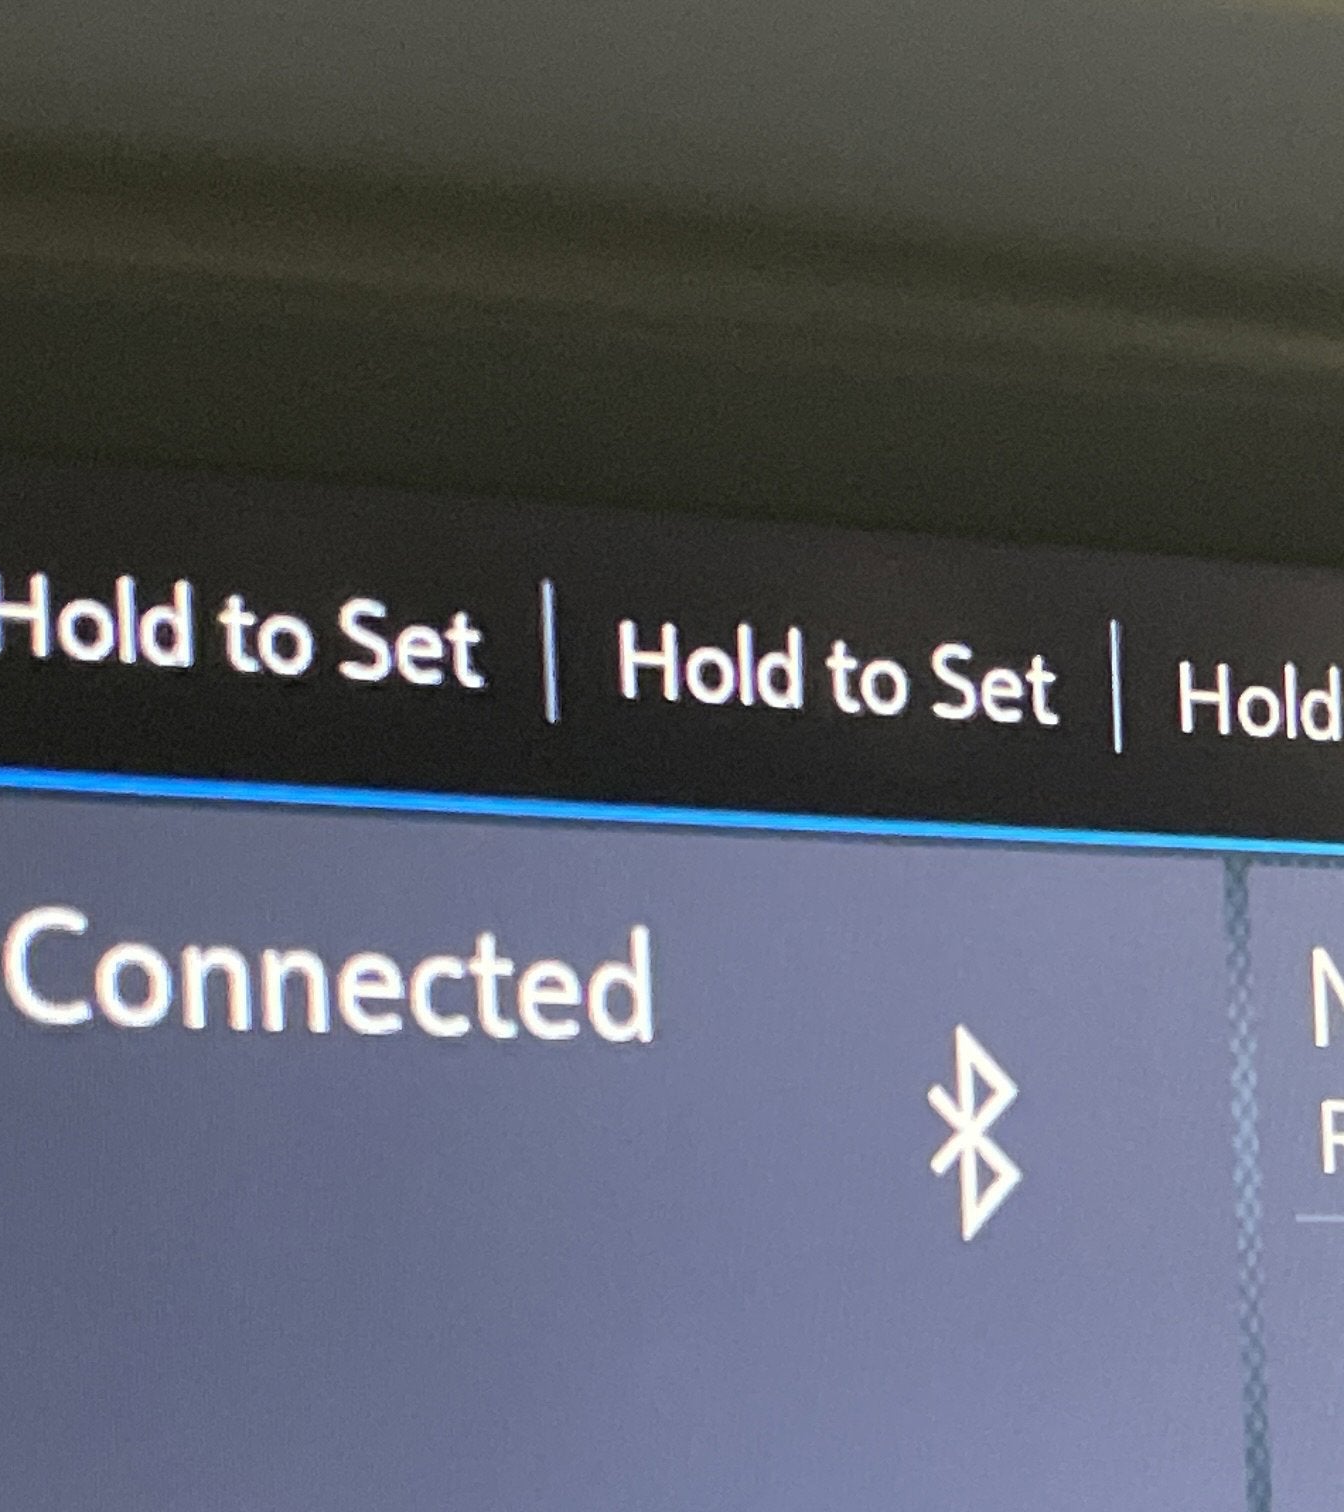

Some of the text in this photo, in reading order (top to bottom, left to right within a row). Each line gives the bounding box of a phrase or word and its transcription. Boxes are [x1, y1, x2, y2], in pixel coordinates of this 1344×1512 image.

[216, 593, 314, 677] to
[337, 596, 486, 690] Set
[618, 619, 1060, 727] Hold to Set
[1178, 659, 1343, 743] Hold
[3, 905, 655, 1044] Connected
